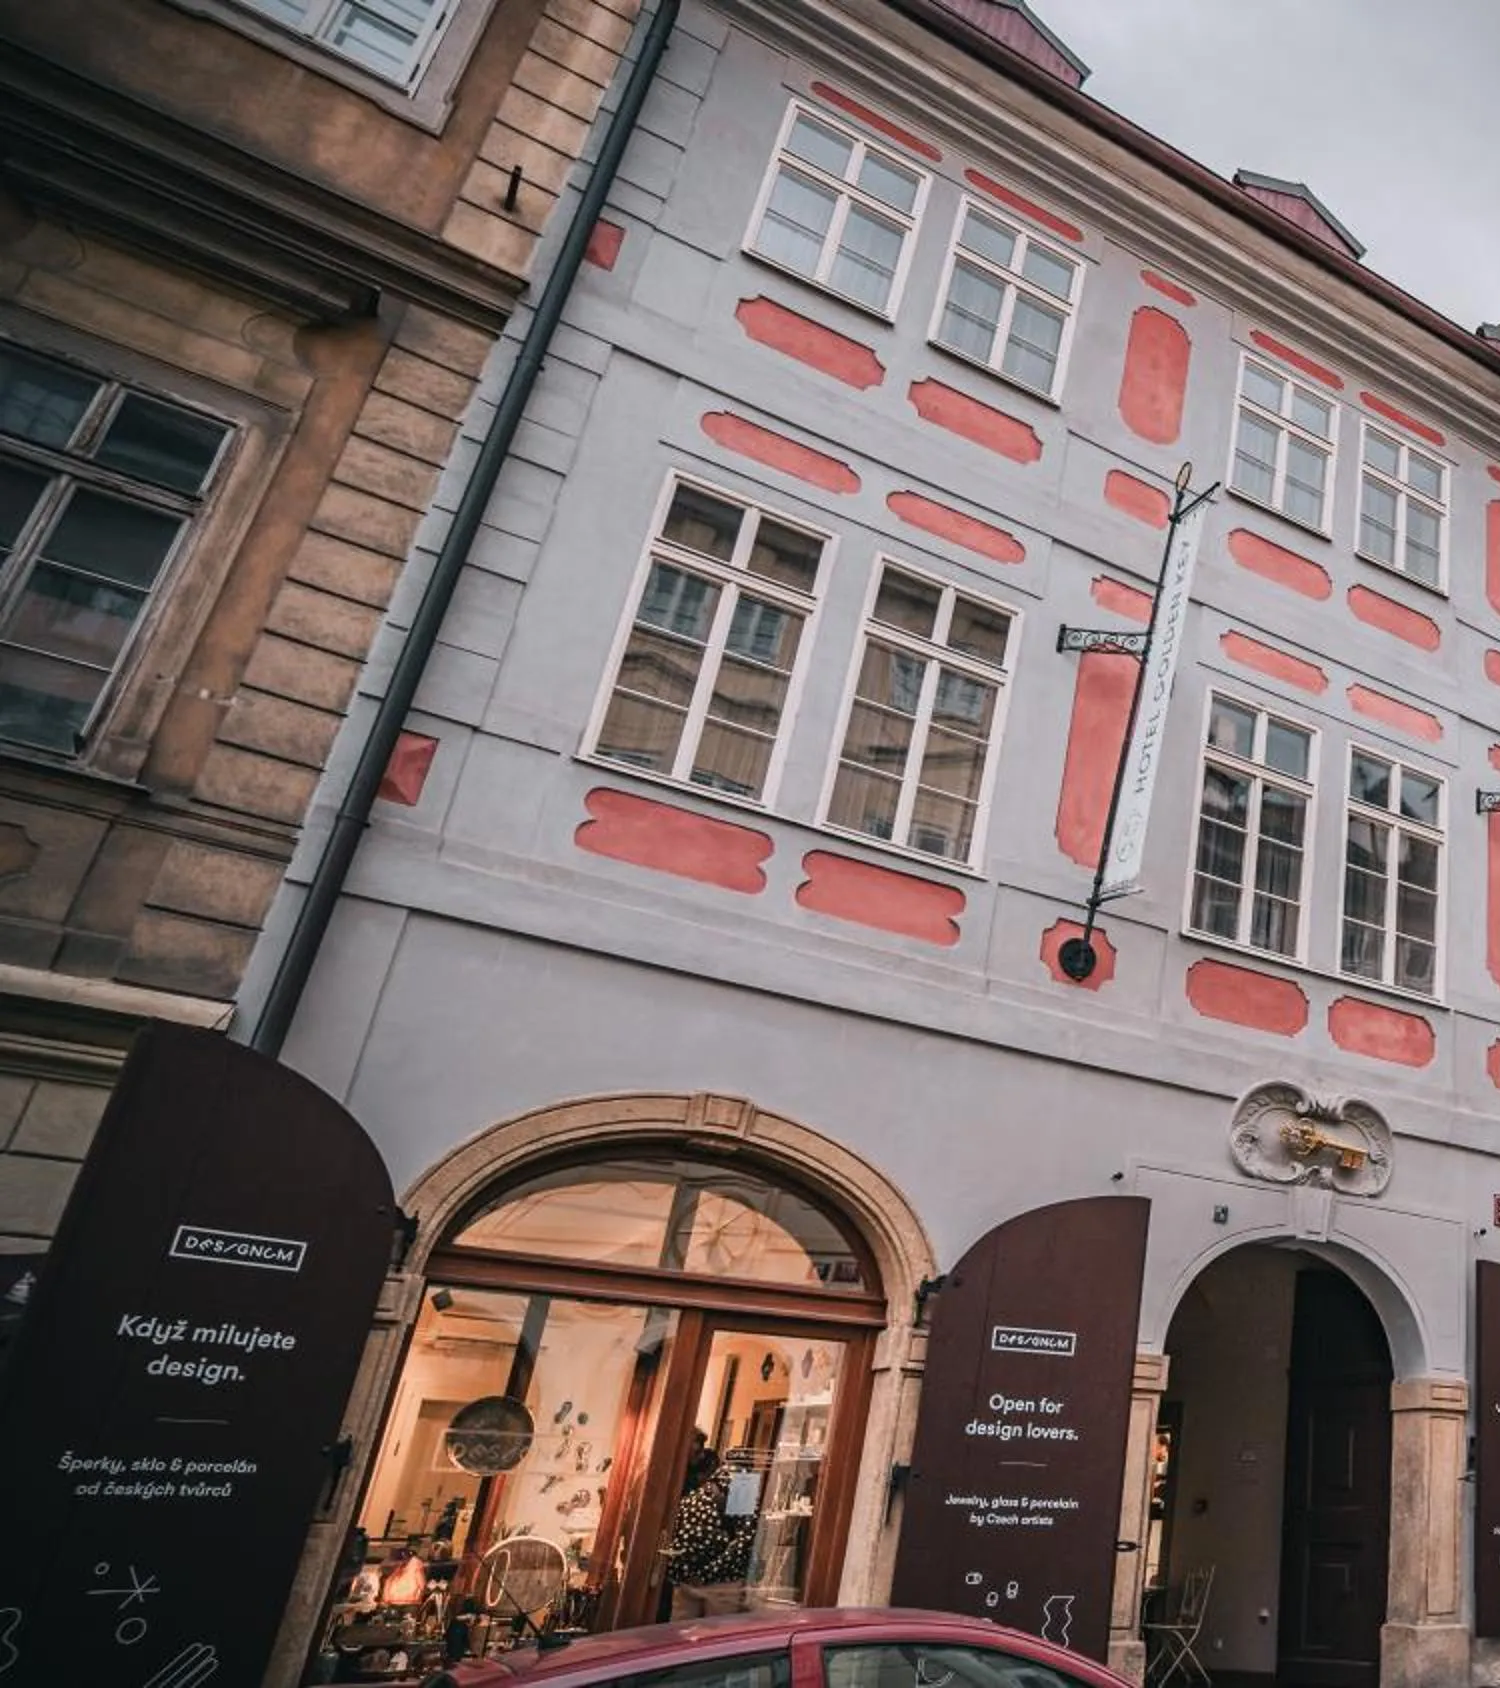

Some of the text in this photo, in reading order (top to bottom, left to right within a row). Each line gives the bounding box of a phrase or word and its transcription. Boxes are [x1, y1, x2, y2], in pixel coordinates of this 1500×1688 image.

[1134, 709, 1161, 794] HOTEL
[117, 1313, 297, 1353] Když milujete
[147, 1353, 247, 1385] design.
[989, 1393, 1064, 1414] Open for
[965, 1418, 1079, 1441] design lovers.
[58, 1450, 126, 1475] Šperky,
[130, 1457, 166, 1472] sklo
[75, 1480, 232, 1499] od českých tvůrců
[991, 1495, 1019, 1509] glass
[1029, 1497, 1079, 1511] porcelain
[969, 1511, 985, 1527] by
[986, 1512, 1018, 1526] Czech
